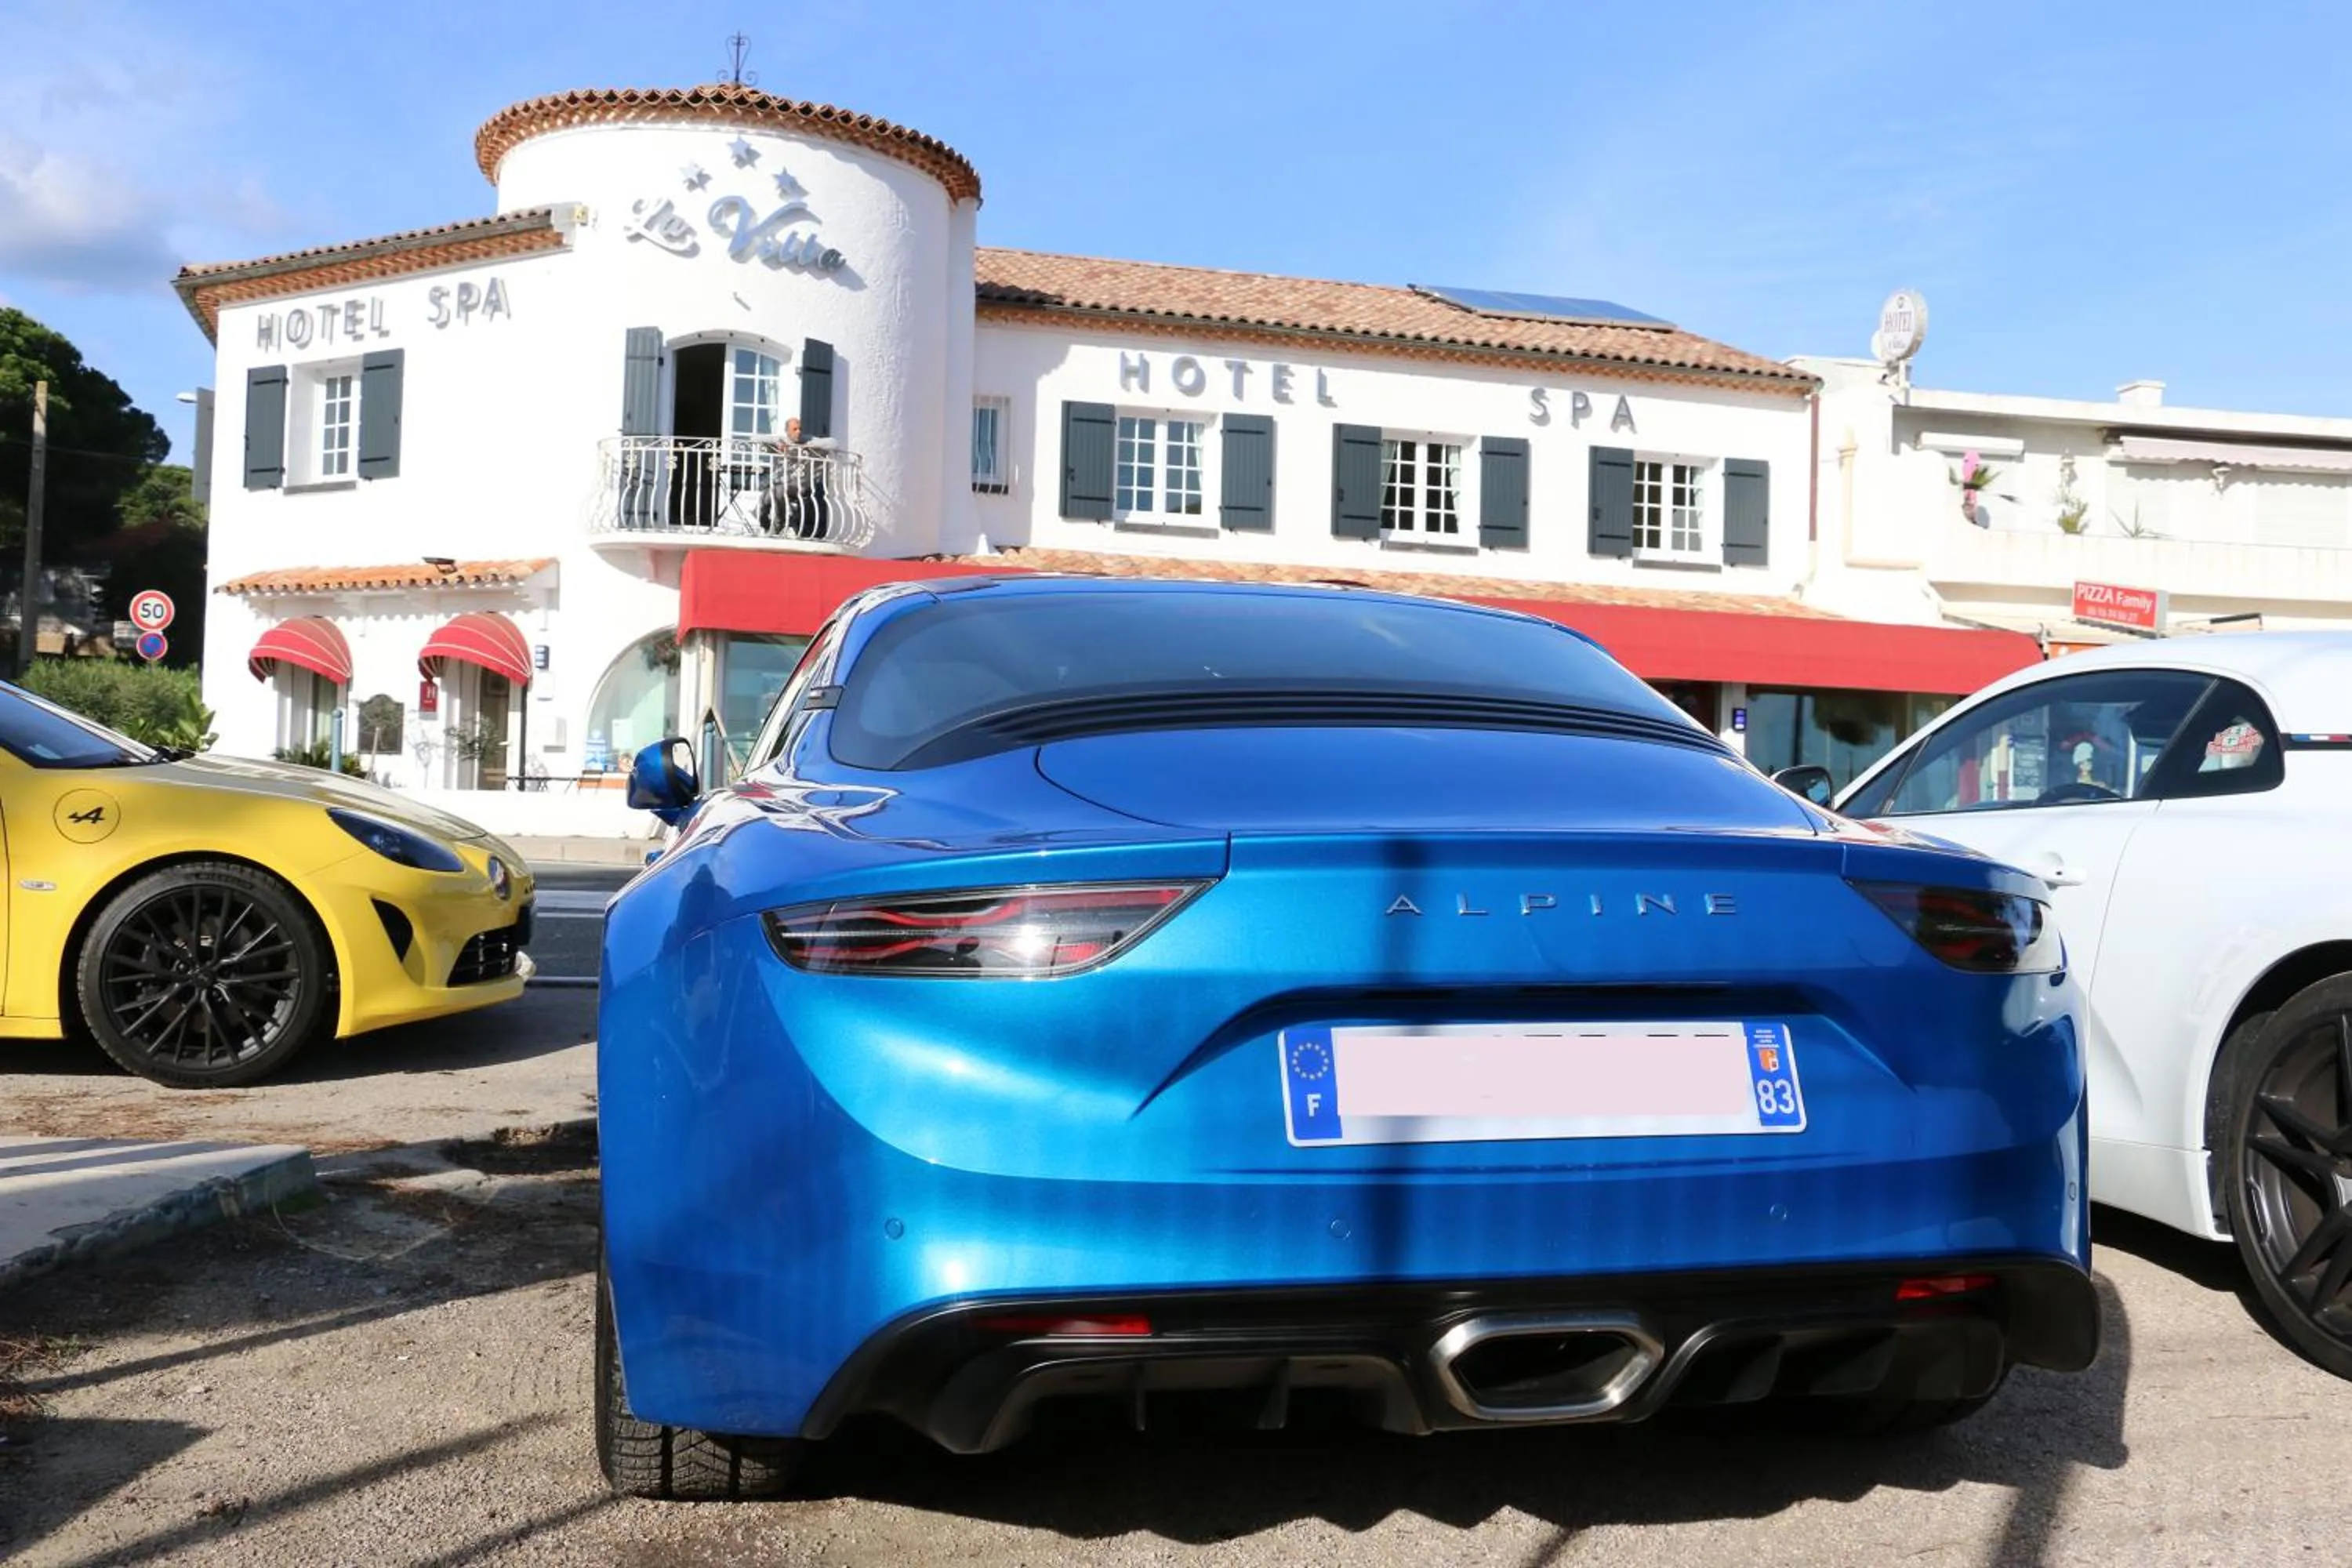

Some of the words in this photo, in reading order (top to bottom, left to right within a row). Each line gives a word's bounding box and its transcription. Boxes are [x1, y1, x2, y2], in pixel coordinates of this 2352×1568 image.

[257, 296, 390, 350] HOTEL
[428, 277, 511, 328] SPA
[1120, 350, 1337, 407] HOTEL
[1530, 387, 1638, 434] SPA
[141, 603, 164, 619] 50
[2076, 584, 2114, 606] PIZZA
[2116, 591, 2153, 614] Family
[1386, 893, 1737, 916] ALPINE
[1307, 1093, 1322, 1117] F
[1757, 1079, 1795, 1114] 83
